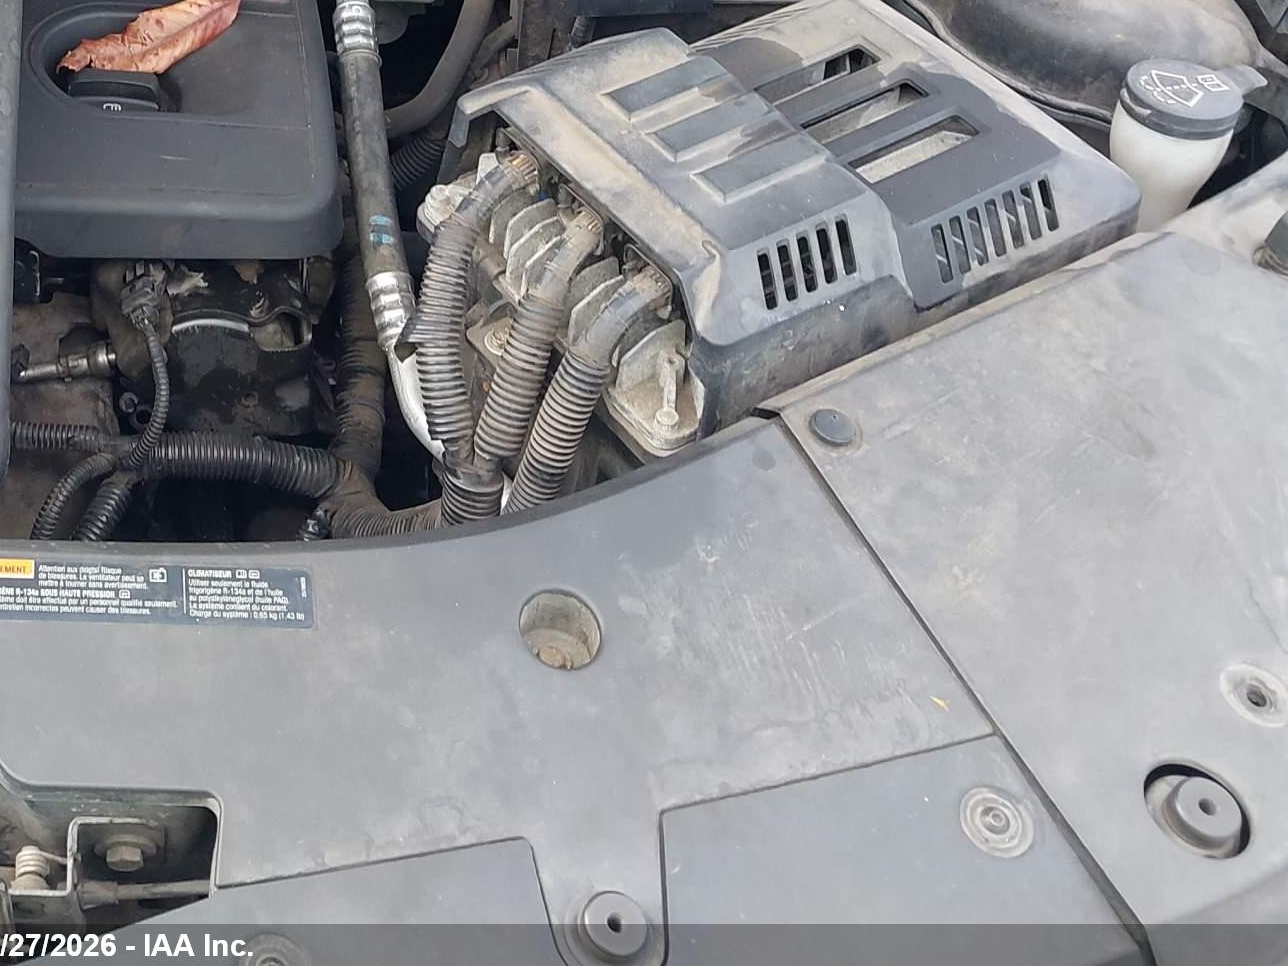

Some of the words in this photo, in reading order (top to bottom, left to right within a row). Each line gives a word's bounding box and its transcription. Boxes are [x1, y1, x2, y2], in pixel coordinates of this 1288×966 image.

[188, 570, 232, 578] CLIMATISEUR
[244, 580, 250, 588] le
[251, 580, 268, 588] fluide
[60, 589, 81, 597] HAUTE
